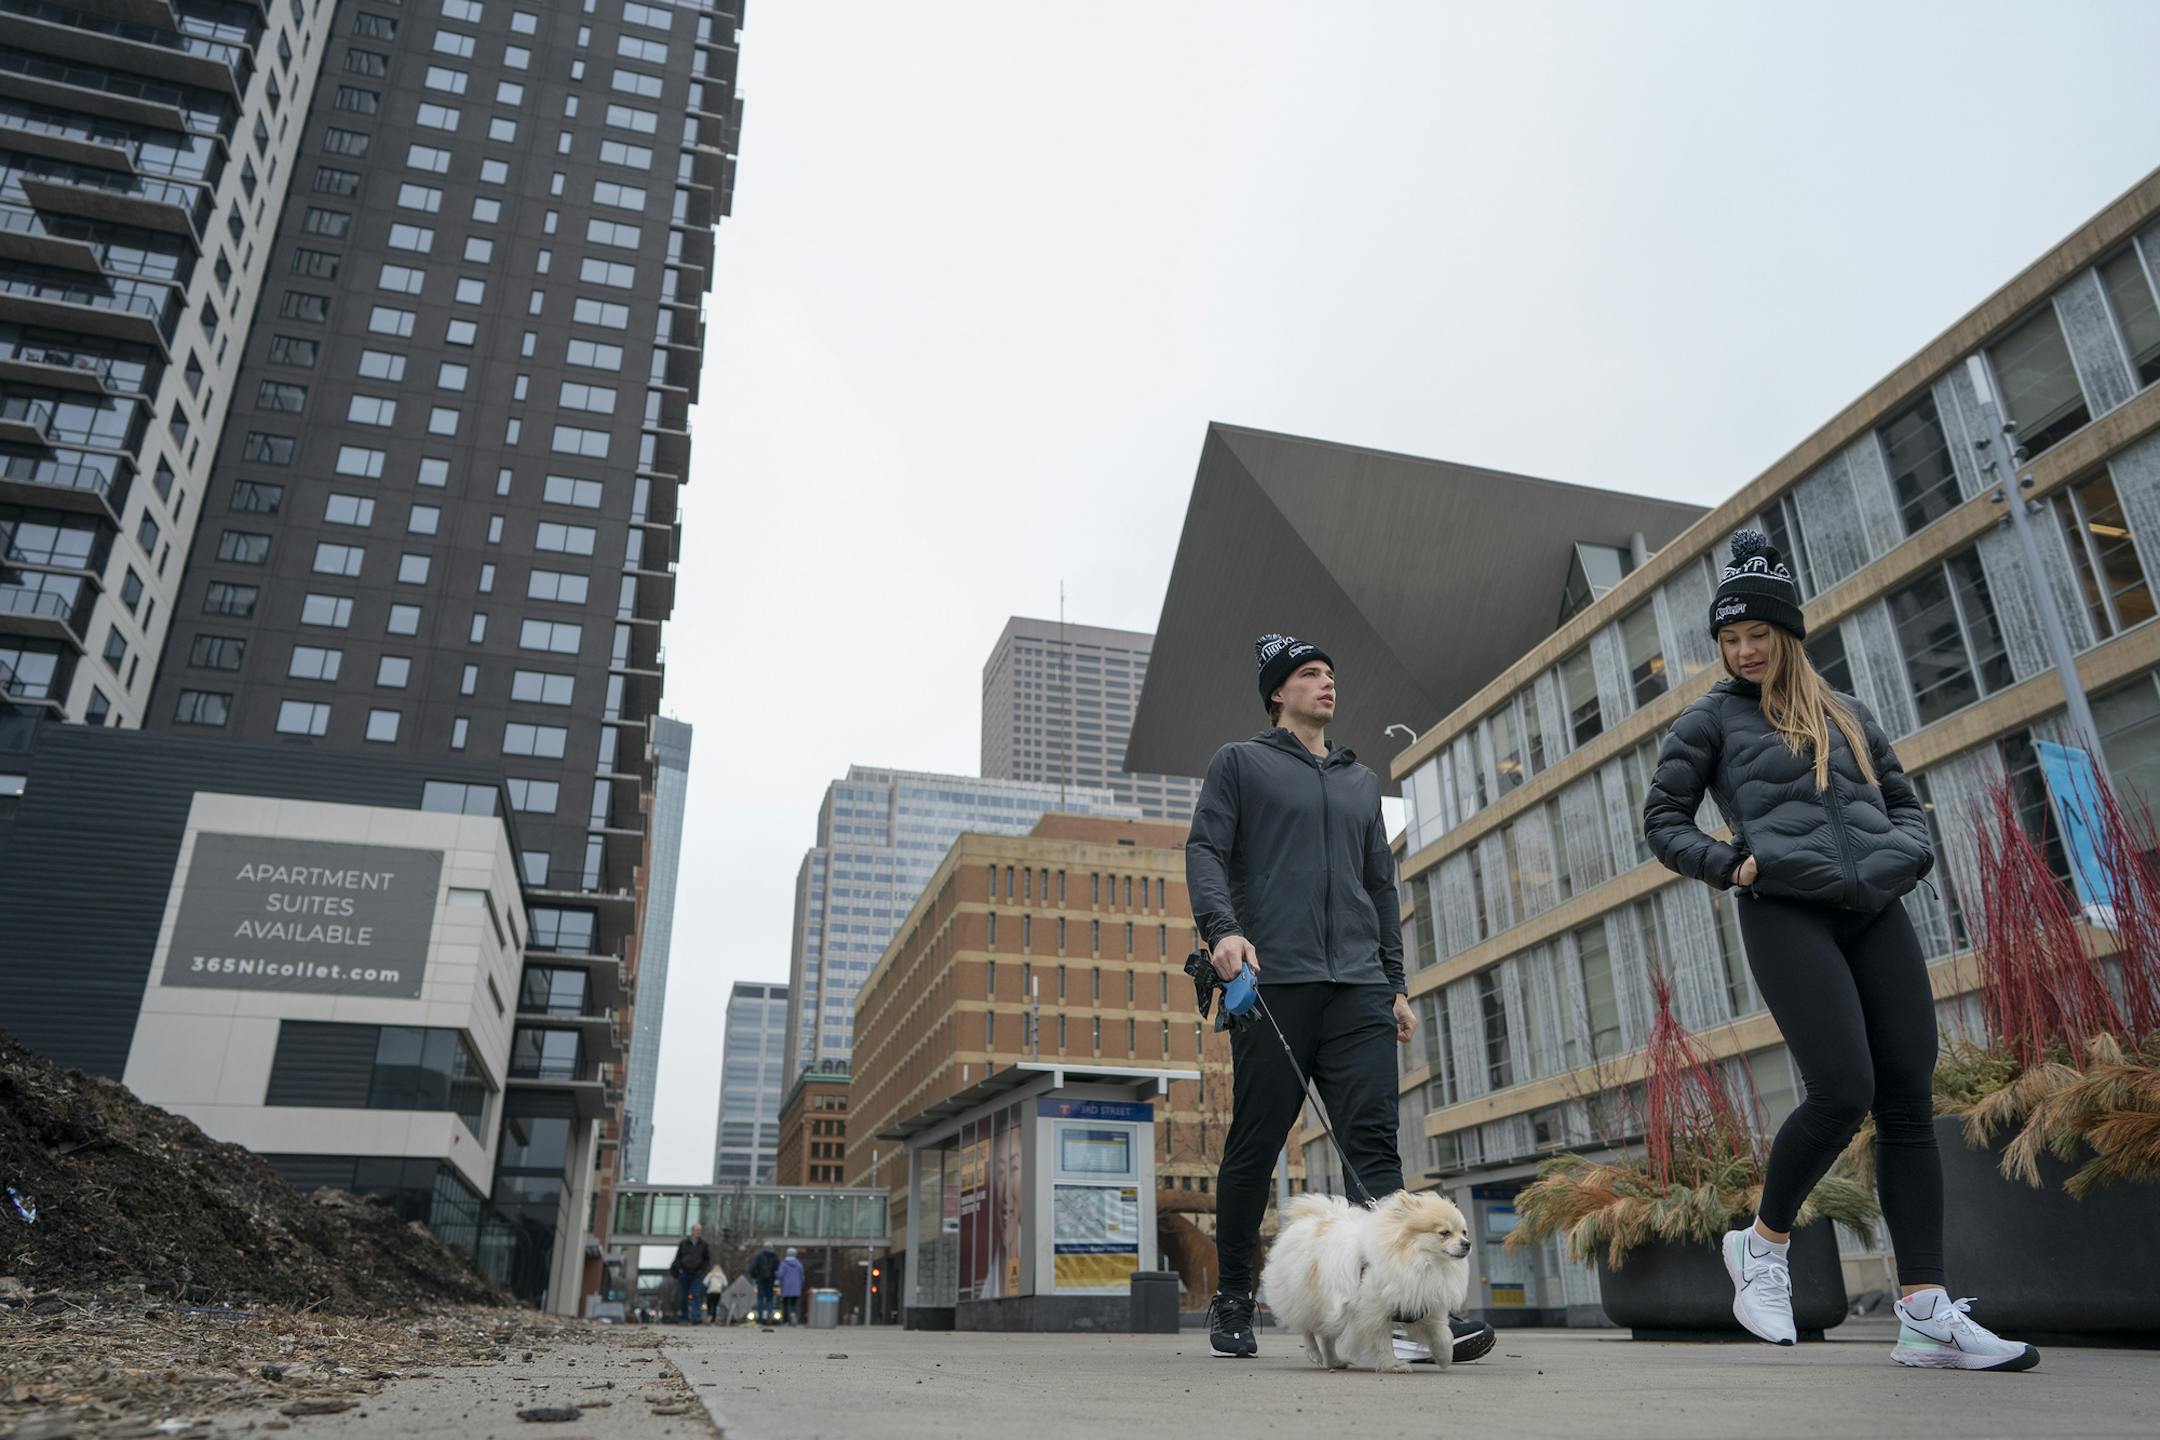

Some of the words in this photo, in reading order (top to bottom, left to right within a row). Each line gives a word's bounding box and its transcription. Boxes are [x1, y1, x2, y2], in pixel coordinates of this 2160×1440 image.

[236, 863, 395, 891] APARTMENT
[265, 893, 355, 917] SUITES
[234, 920, 373, 946] AVAILABLE
[191, 957, 400, 982] 365Nicollet.com
[1100, 1105, 1131, 1116] STREET
